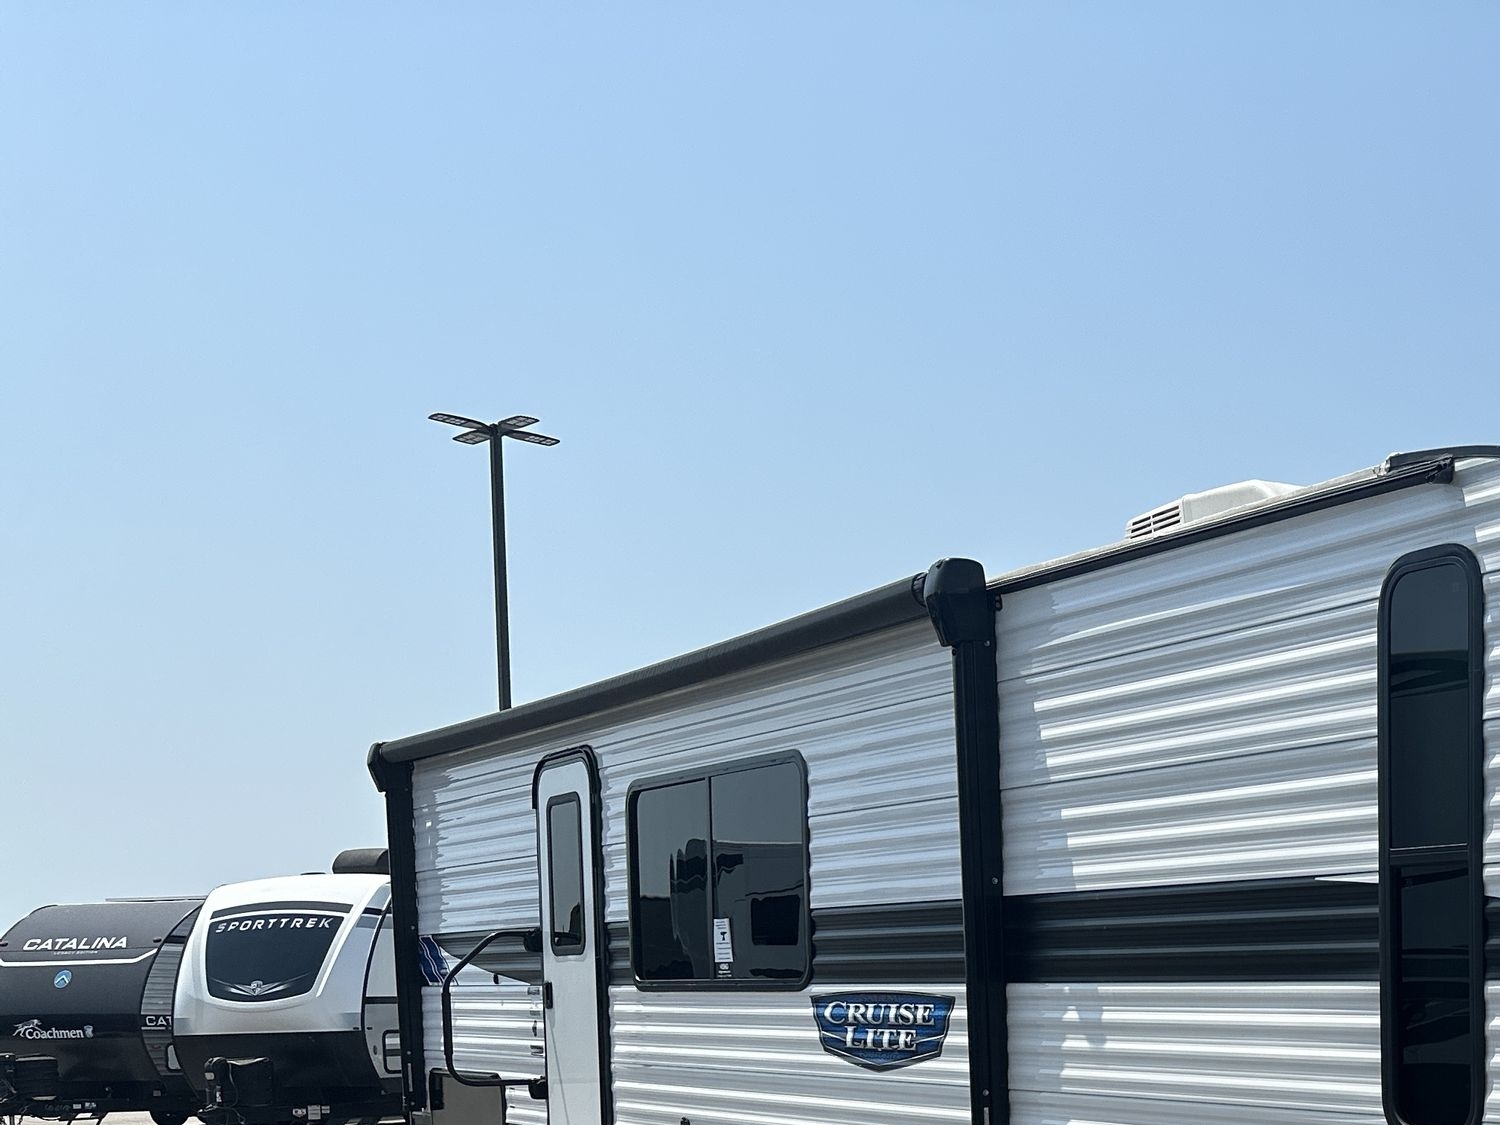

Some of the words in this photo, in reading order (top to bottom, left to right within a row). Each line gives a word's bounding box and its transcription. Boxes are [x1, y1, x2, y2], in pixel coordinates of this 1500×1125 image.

[215, 917, 333, 933] SPORTTREK
[22, 936, 127, 951] CATALINA
[823, 1001, 935, 1026] CRUISE
[25, 1027, 84, 1039] Coachmen
[844, 1025, 917, 1051] LITE
